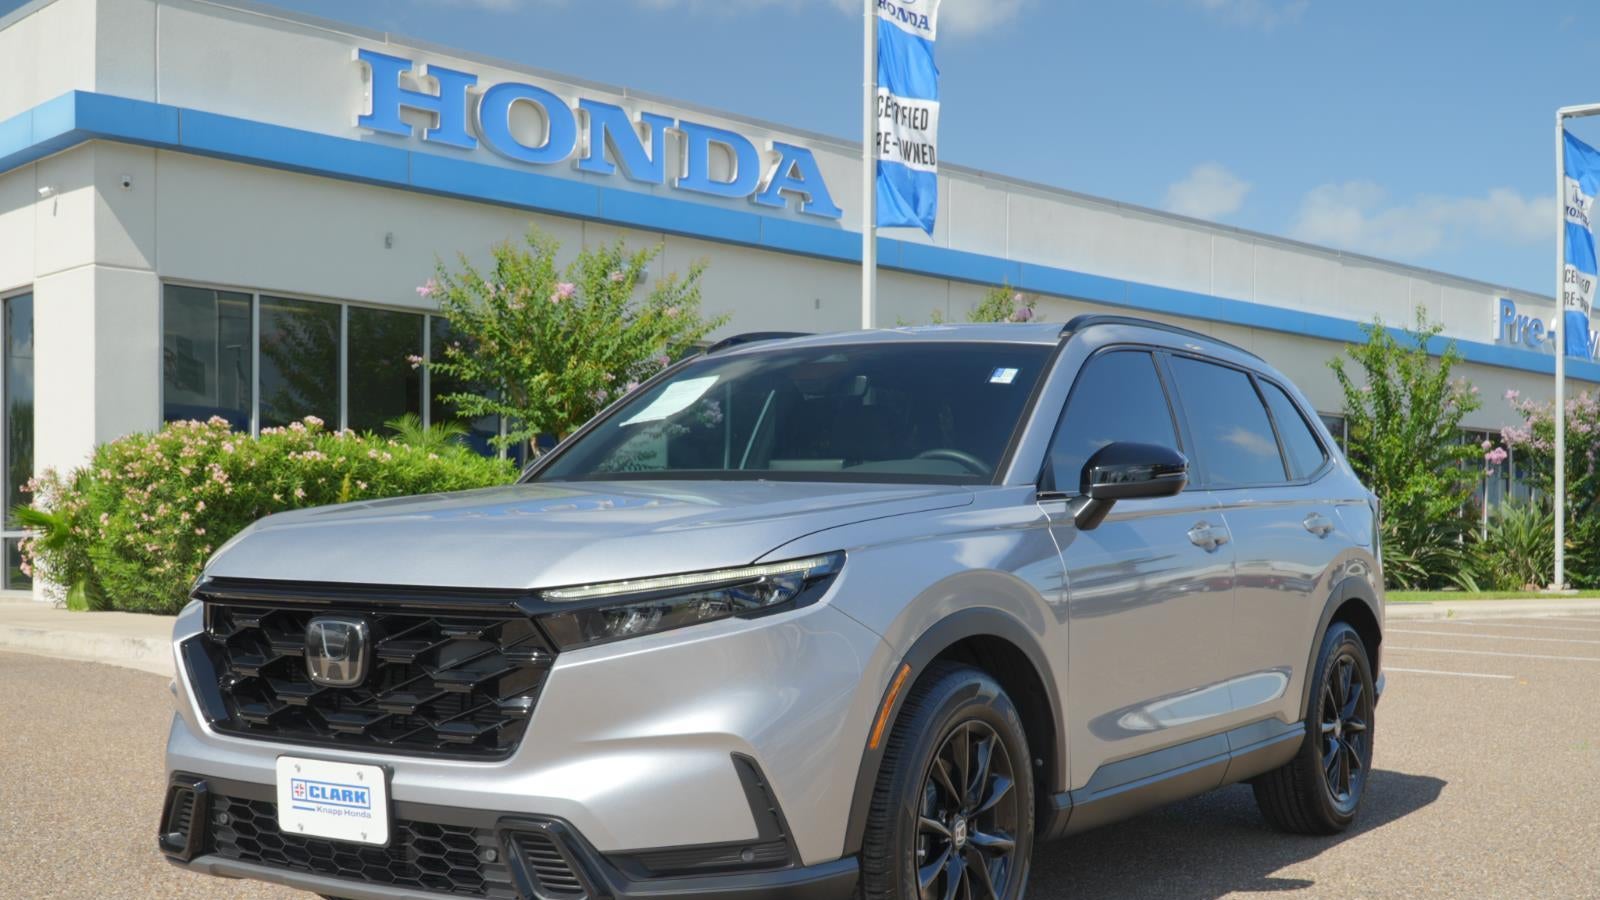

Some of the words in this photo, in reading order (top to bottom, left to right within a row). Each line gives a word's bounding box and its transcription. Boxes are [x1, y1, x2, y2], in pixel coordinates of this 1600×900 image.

[877, 0, 930, 31] HONDA
[877, 95, 929, 131] CETFIED
[354, 48, 843, 219] HONDA
[309, 785, 367, 804] CLARK
[316, 806, 343, 816] Knapp
[344, 808, 371, 819] Honda
